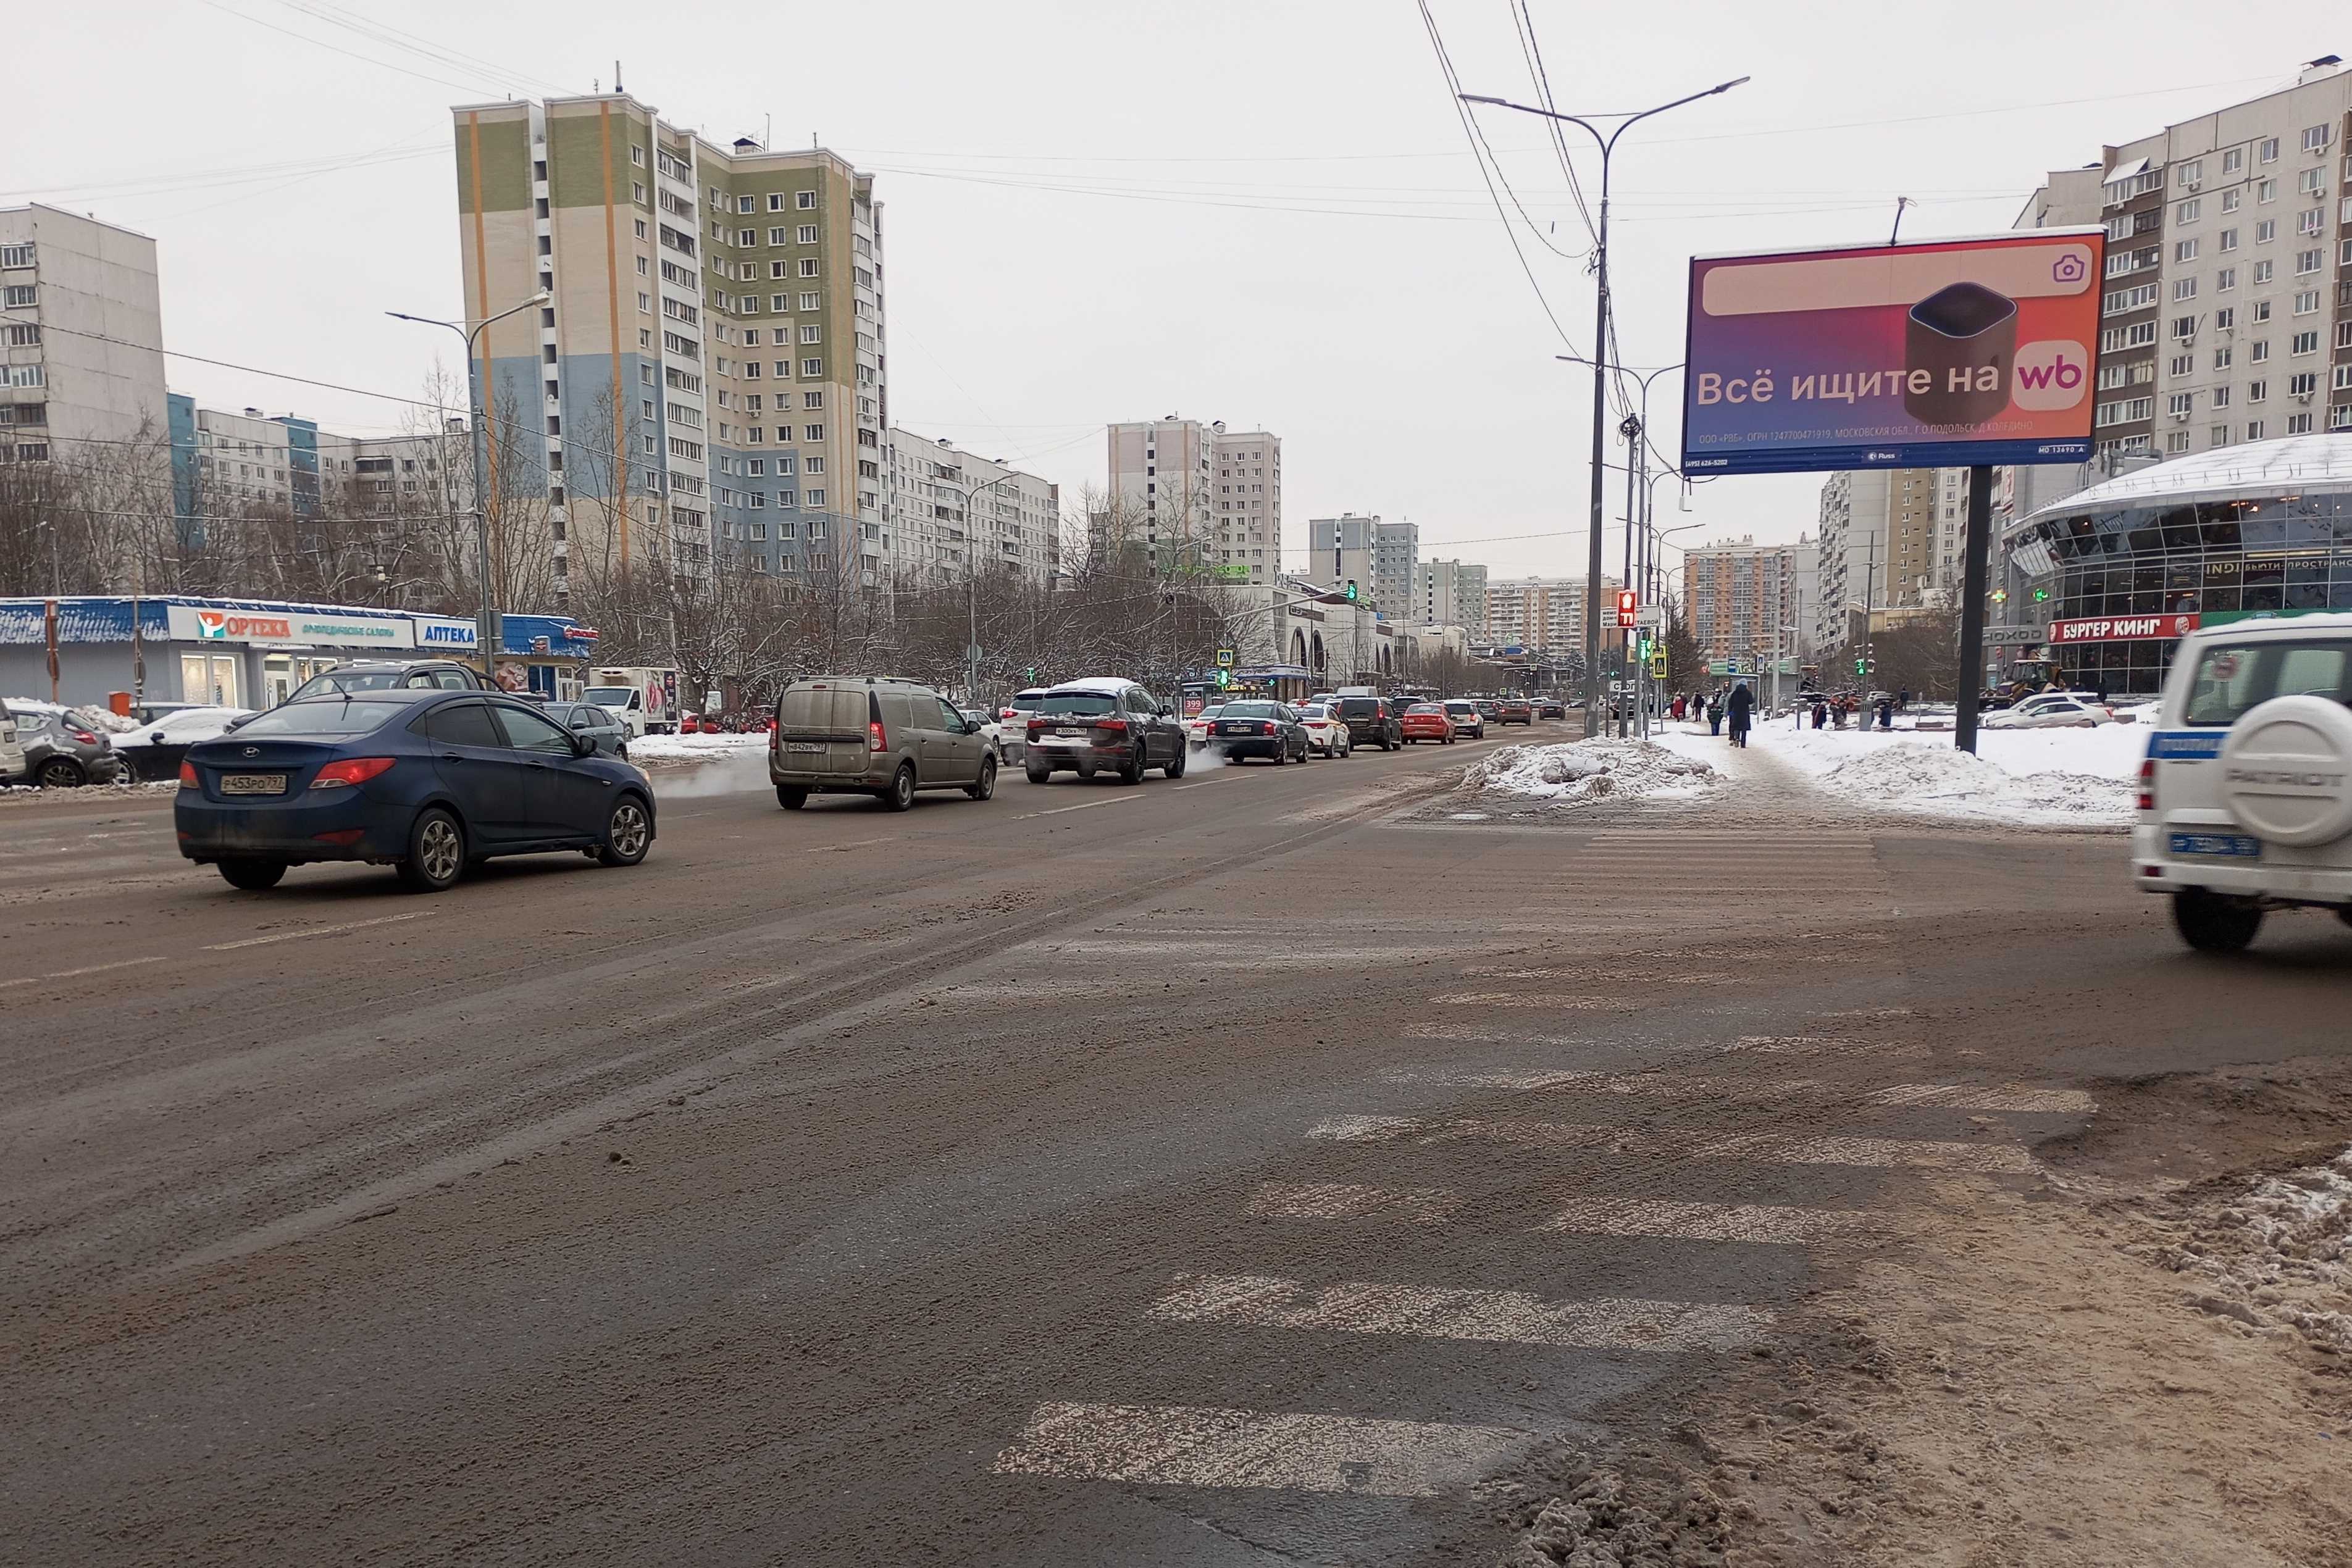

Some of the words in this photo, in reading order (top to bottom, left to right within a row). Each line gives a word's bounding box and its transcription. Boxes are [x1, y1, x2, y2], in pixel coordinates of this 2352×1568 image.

[2018, 354, 2082, 390] wb
[1698, 369, 1773, 405] Всё
[1792, 369, 1931, 404] ищите
[1948, 365, 1999, 393] на
[1747, 432, 1768, 441] ОГРН
[1836, 427, 1889, 438] МОСКОВСКАЯ
[227, 617, 291, 637] ОРТЕКА
[424, 626, 475, 643] АПТЕКА
[2063, 622, 2111, 639] БУРГЕР
[2114, 619, 2161, 636] КИНГ
